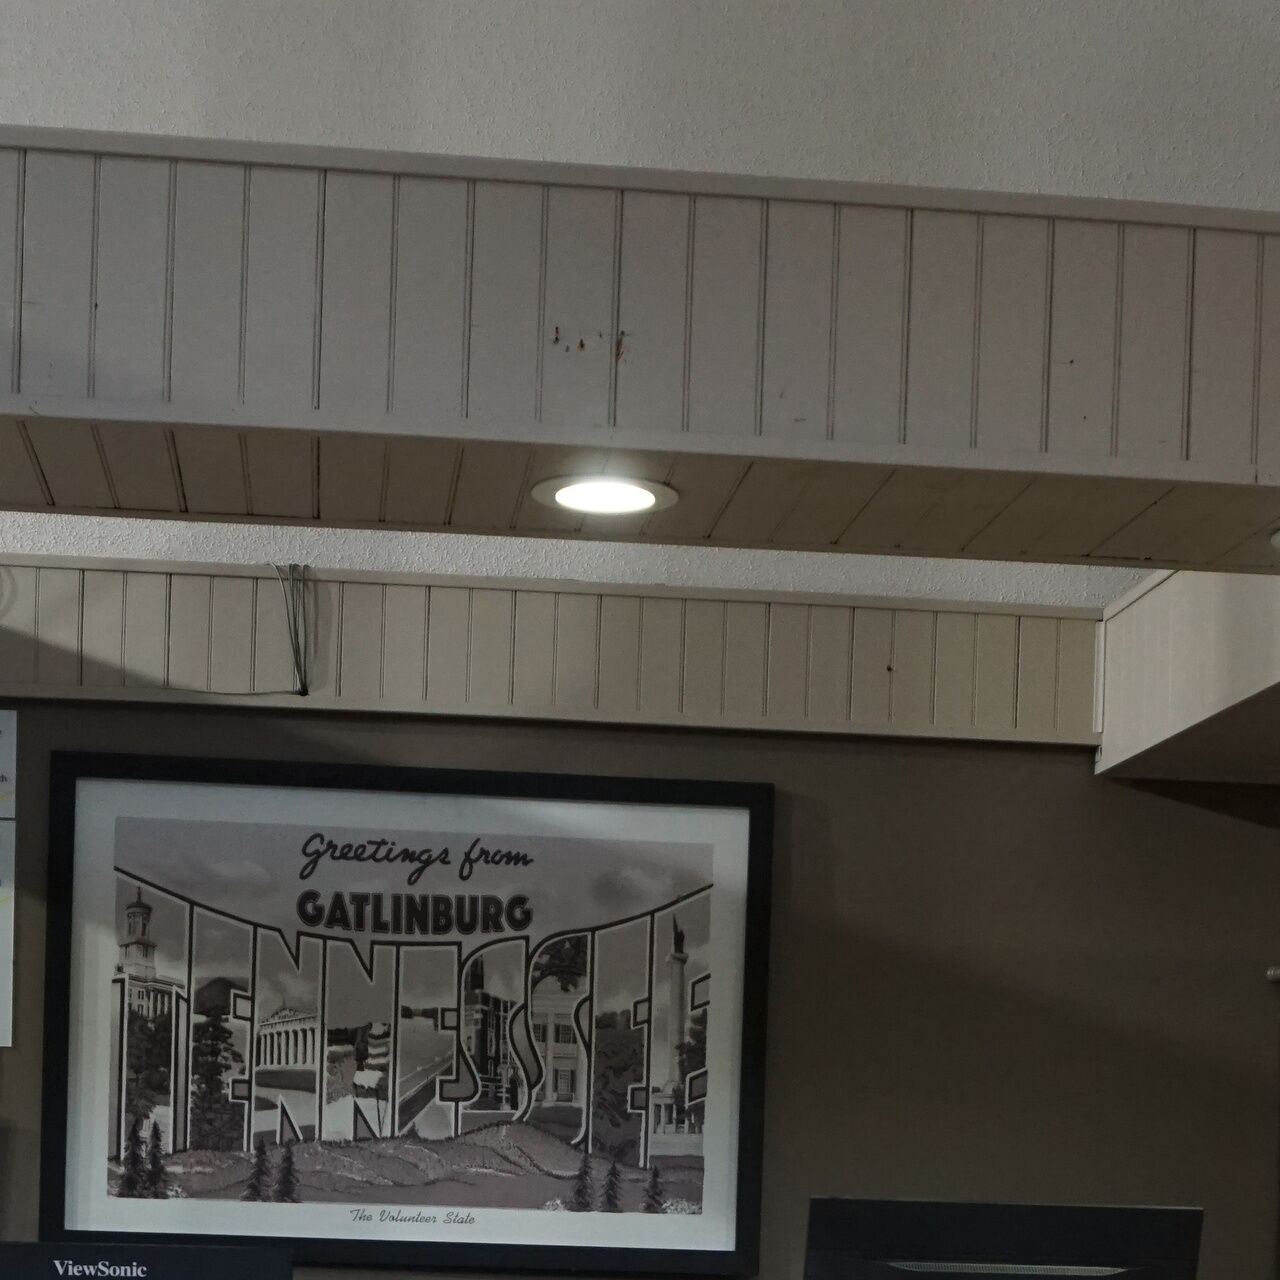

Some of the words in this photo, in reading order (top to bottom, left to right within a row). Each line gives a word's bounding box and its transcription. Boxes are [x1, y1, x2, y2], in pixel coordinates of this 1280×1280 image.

[299, 833, 450, 885] Greetings
[459, 838, 533, 880] from
[296, 889, 533, 935] GATLINBURG
[112, 866, 714, 1172] TENNESSEE
[350, 1209, 373, 1222] The
[379, 1209, 437, 1223] Volunteer
[443, 1211, 475, 1224] State
[53, 1260, 147, 1278] ViewSonic
